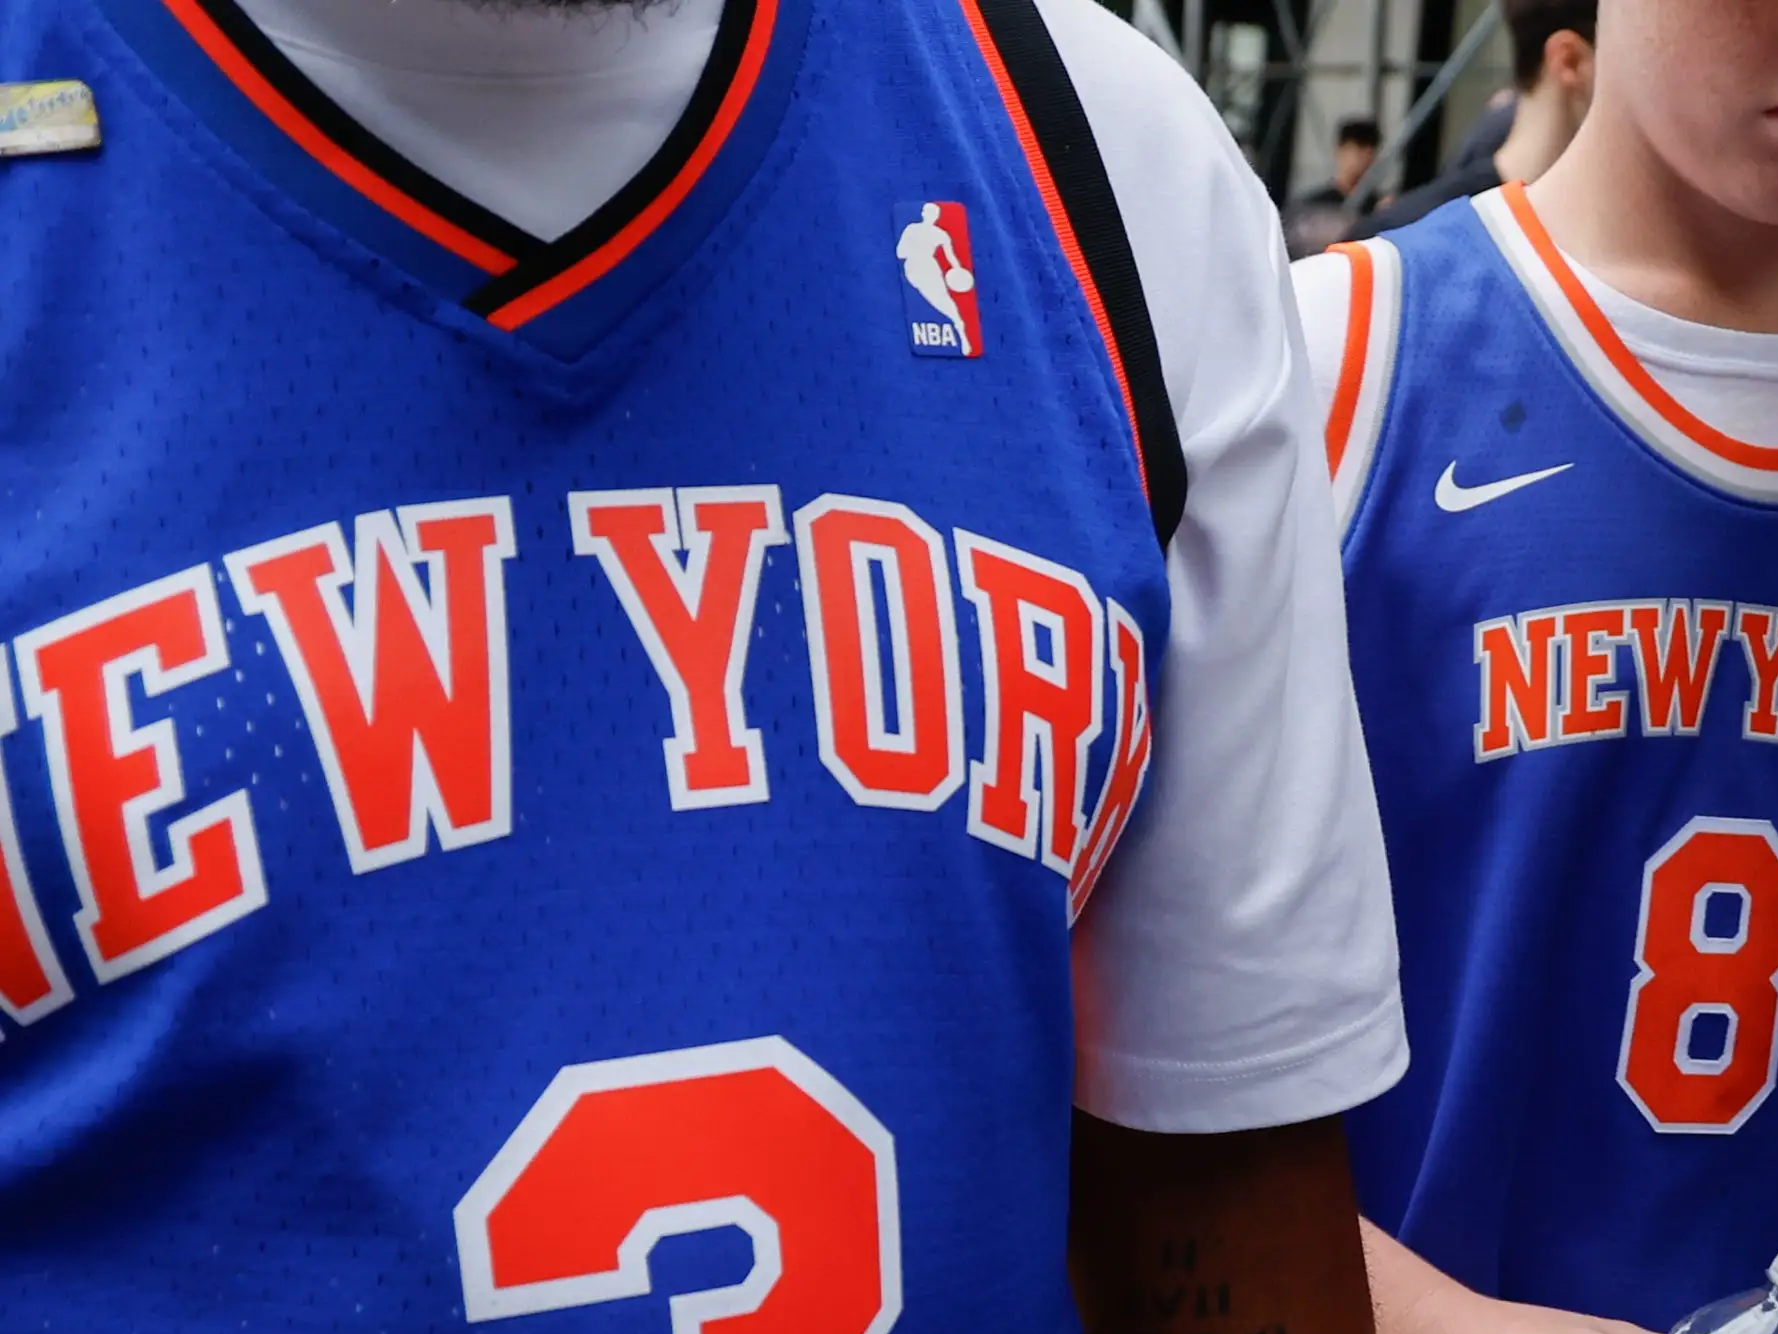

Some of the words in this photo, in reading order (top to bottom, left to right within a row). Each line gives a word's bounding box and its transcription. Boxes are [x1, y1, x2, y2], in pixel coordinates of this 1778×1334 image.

[911, 321, 959, 348] NBA
[568, 484, 1152, 929] YORK
[1474, 598, 1733, 763] NEW
